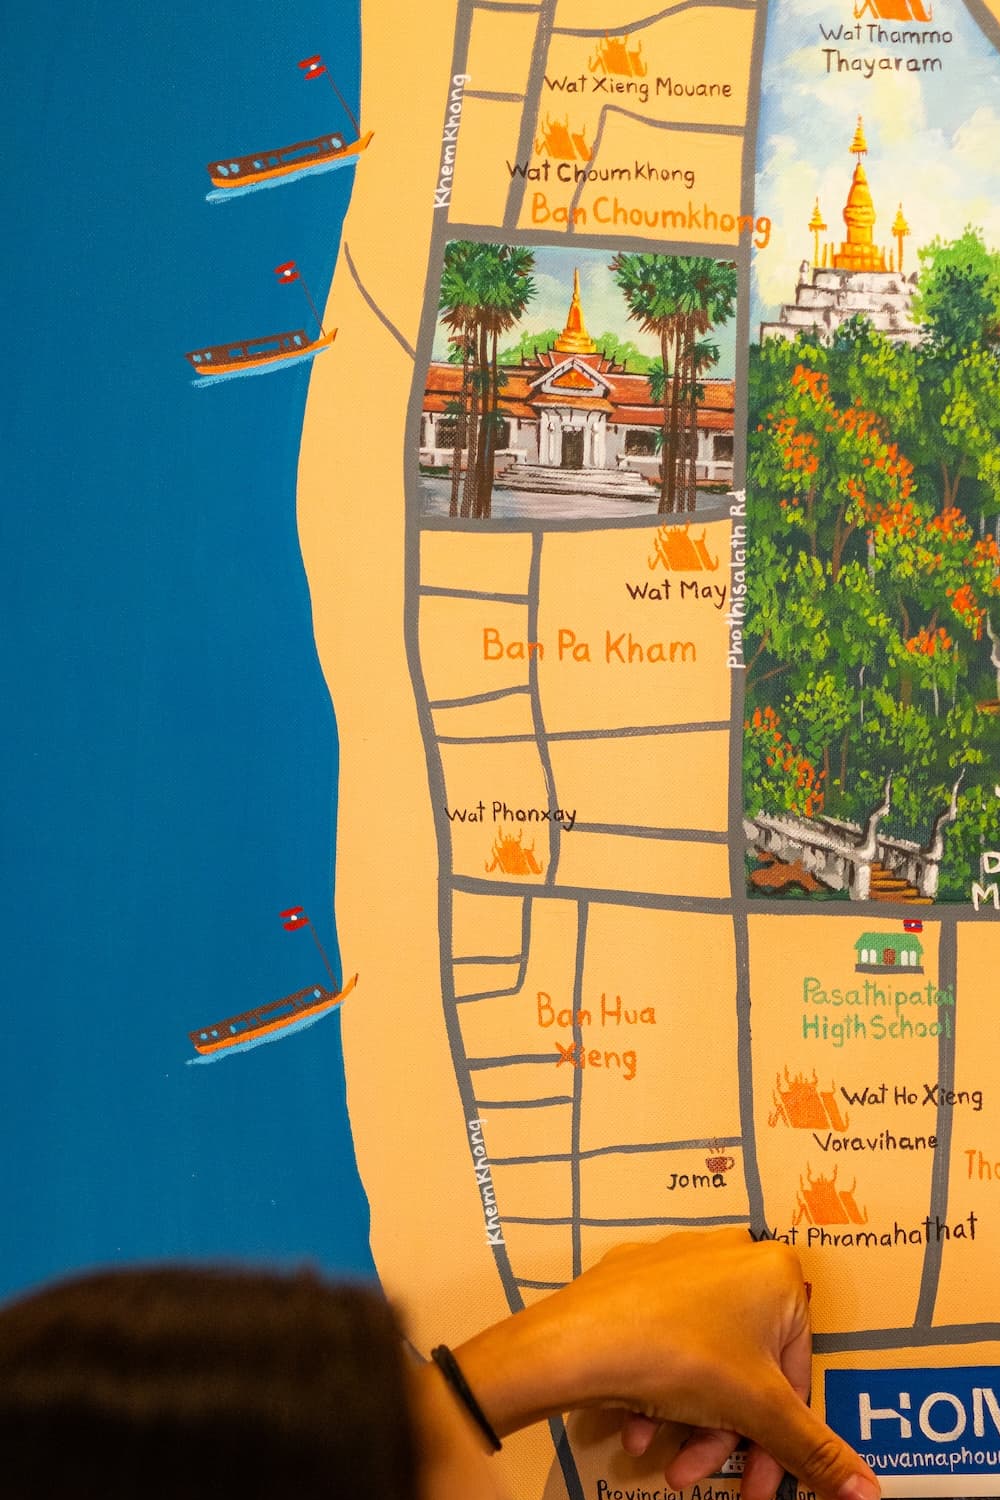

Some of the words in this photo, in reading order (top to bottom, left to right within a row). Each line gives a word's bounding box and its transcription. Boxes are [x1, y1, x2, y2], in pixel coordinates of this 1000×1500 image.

[819, 23, 862, 41] Wat
[866, 24, 953, 45] Thammo
[821, 49, 943, 78] Thayaram
[543, 74, 587, 94] Wat
[592, 76, 648, 103] Xieng
[656, 77, 732, 98] Mouane
[506, 159, 550, 182] Wat
[531, 192, 587, 225] Ban
[728, 488, 748, 518] Rd
[625, 579, 673, 601] Wat
[680, 580, 727, 609] May
[483, 627, 544, 661] Ban
[557, 628, 591, 662] Pa
[605, 630, 697, 663] Kham
[444, 801, 486, 823] Wat
[492, 801, 577, 832] Phonxay
[537, 991, 592, 1028] Ban
[601, 993, 657, 1028] Hua
[869, 1013, 951, 1040] School
[554, 1041, 638, 1081] Xieng
[840, 1084, 888, 1106] Wat
[894, 1086, 919, 1106] Ho
[922, 1084, 983, 1111] Xieng
[812, 1130, 939, 1152] Voravihane
